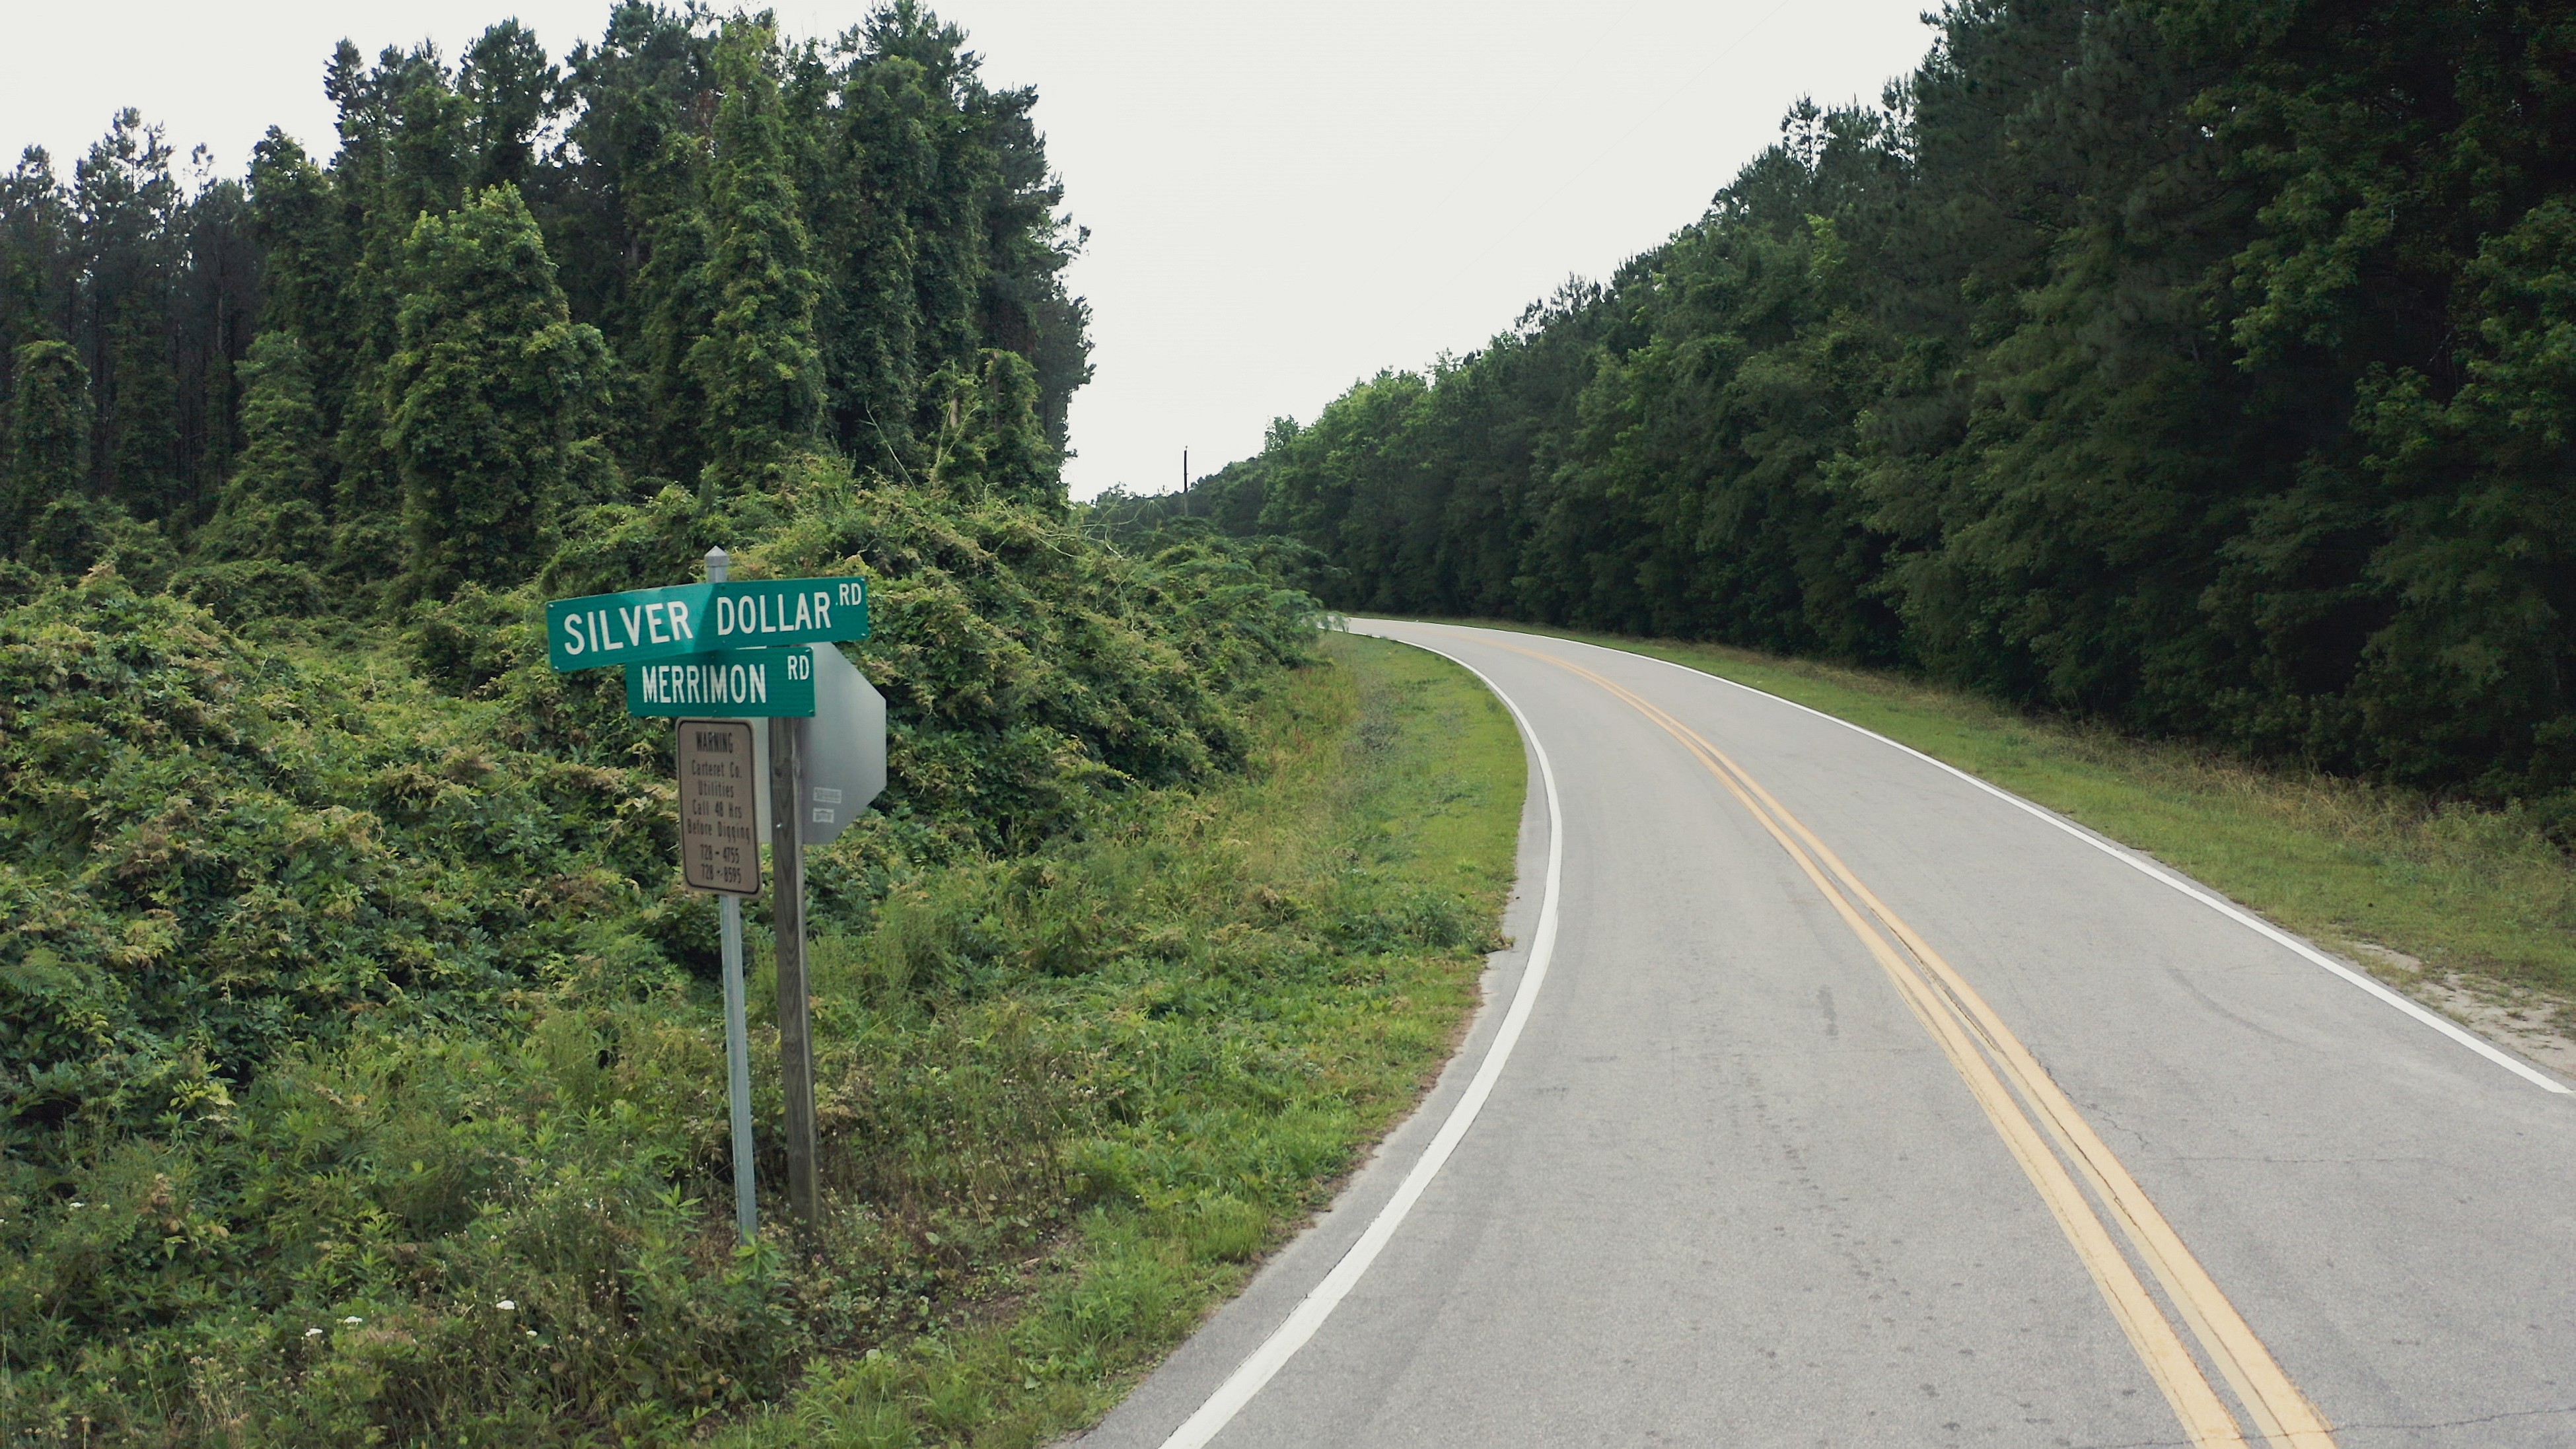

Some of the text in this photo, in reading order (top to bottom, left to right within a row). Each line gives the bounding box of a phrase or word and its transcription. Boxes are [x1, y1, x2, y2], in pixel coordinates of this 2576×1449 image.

[563, 583, 862, 655] SILVER DOLLAR RD
[641, 655, 810, 703] MERRIMON RD
[696, 731, 733, 753] WARNING
[692, 760, 742, 779] Carteret Co.
[698, 780, 734, 798] Utilities
[692, 799, 742, 818] Call 48 Hrs
[687, 818, 750, 845] Before Digging
